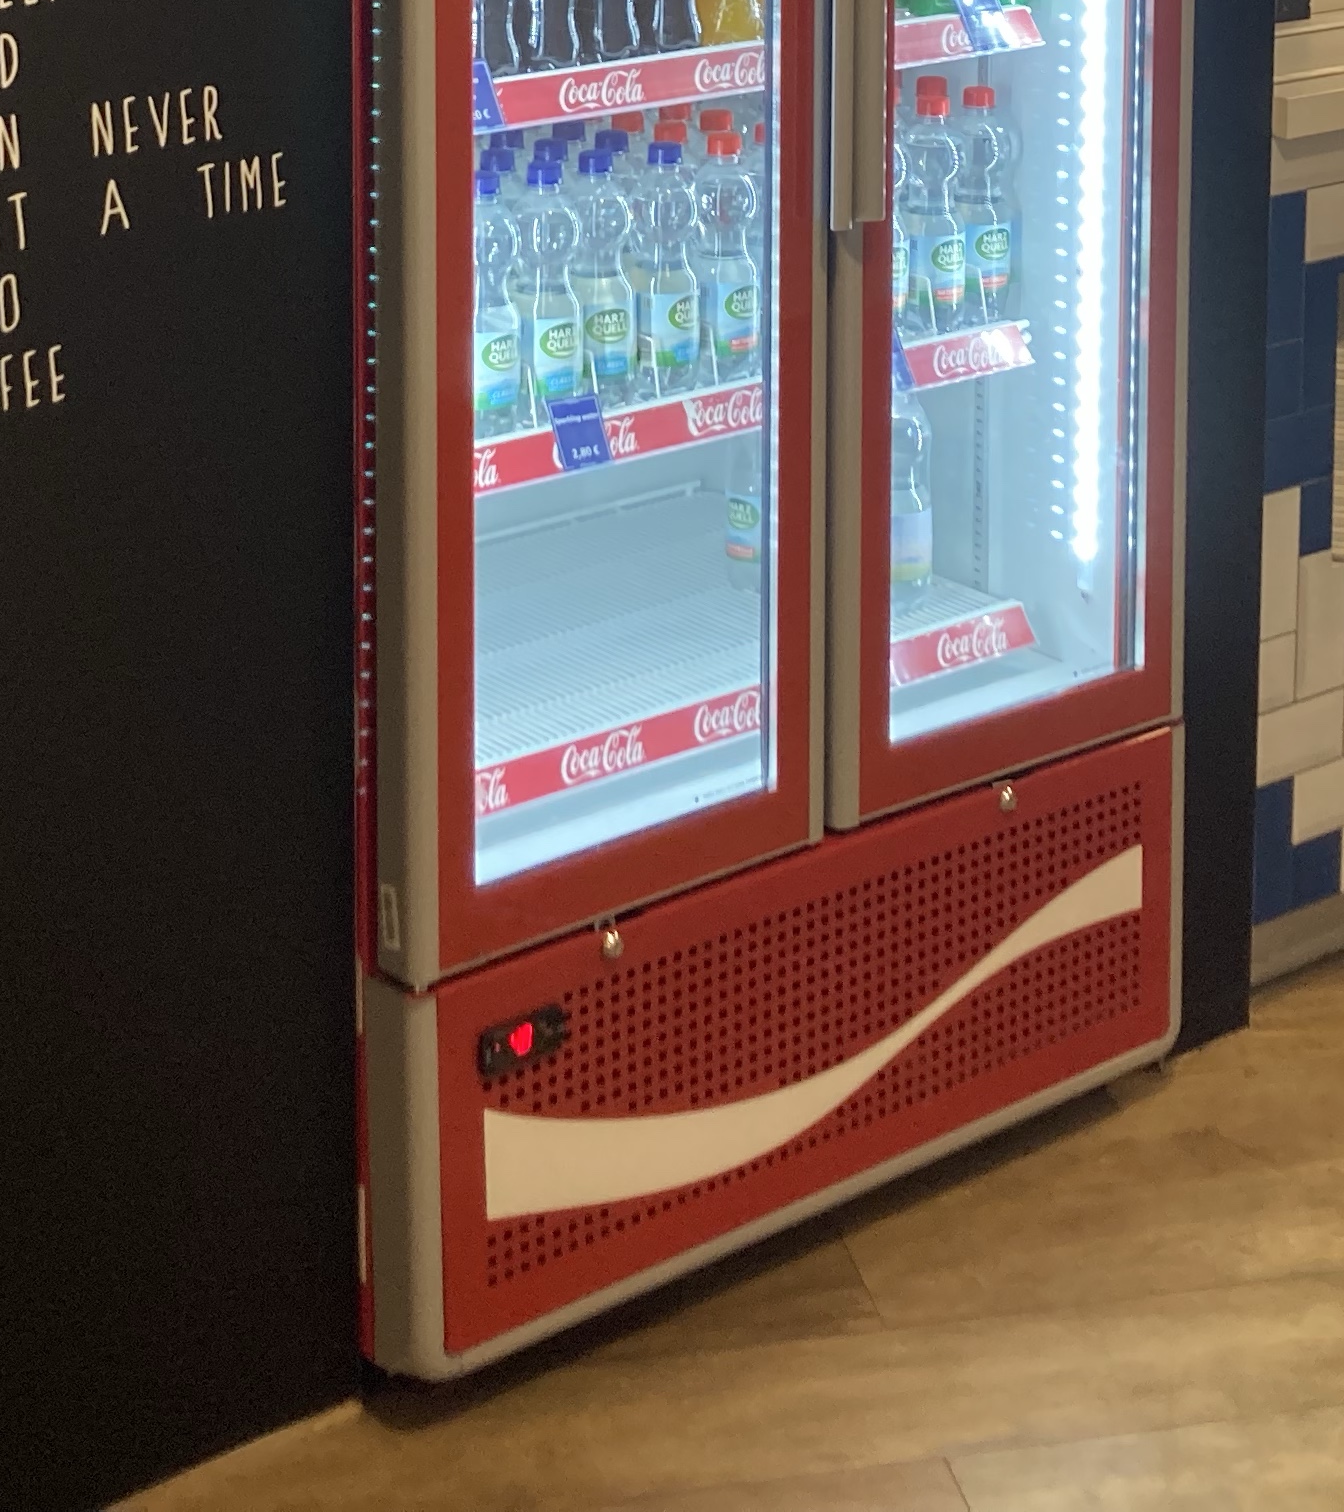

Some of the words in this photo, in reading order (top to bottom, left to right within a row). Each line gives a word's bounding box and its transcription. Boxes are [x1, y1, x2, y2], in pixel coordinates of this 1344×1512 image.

[558, 68, 645, 113] Coca-Cola
[90, 84, 224, 158] NEVER
[99, 177, 131, 237] A
[195, 150, 287, 220] TIME
[592, 322, 627, 336] QUELL
[593, 311, 625, 324] HARZ
[560, 723, 647, 785] Coca-Cola
